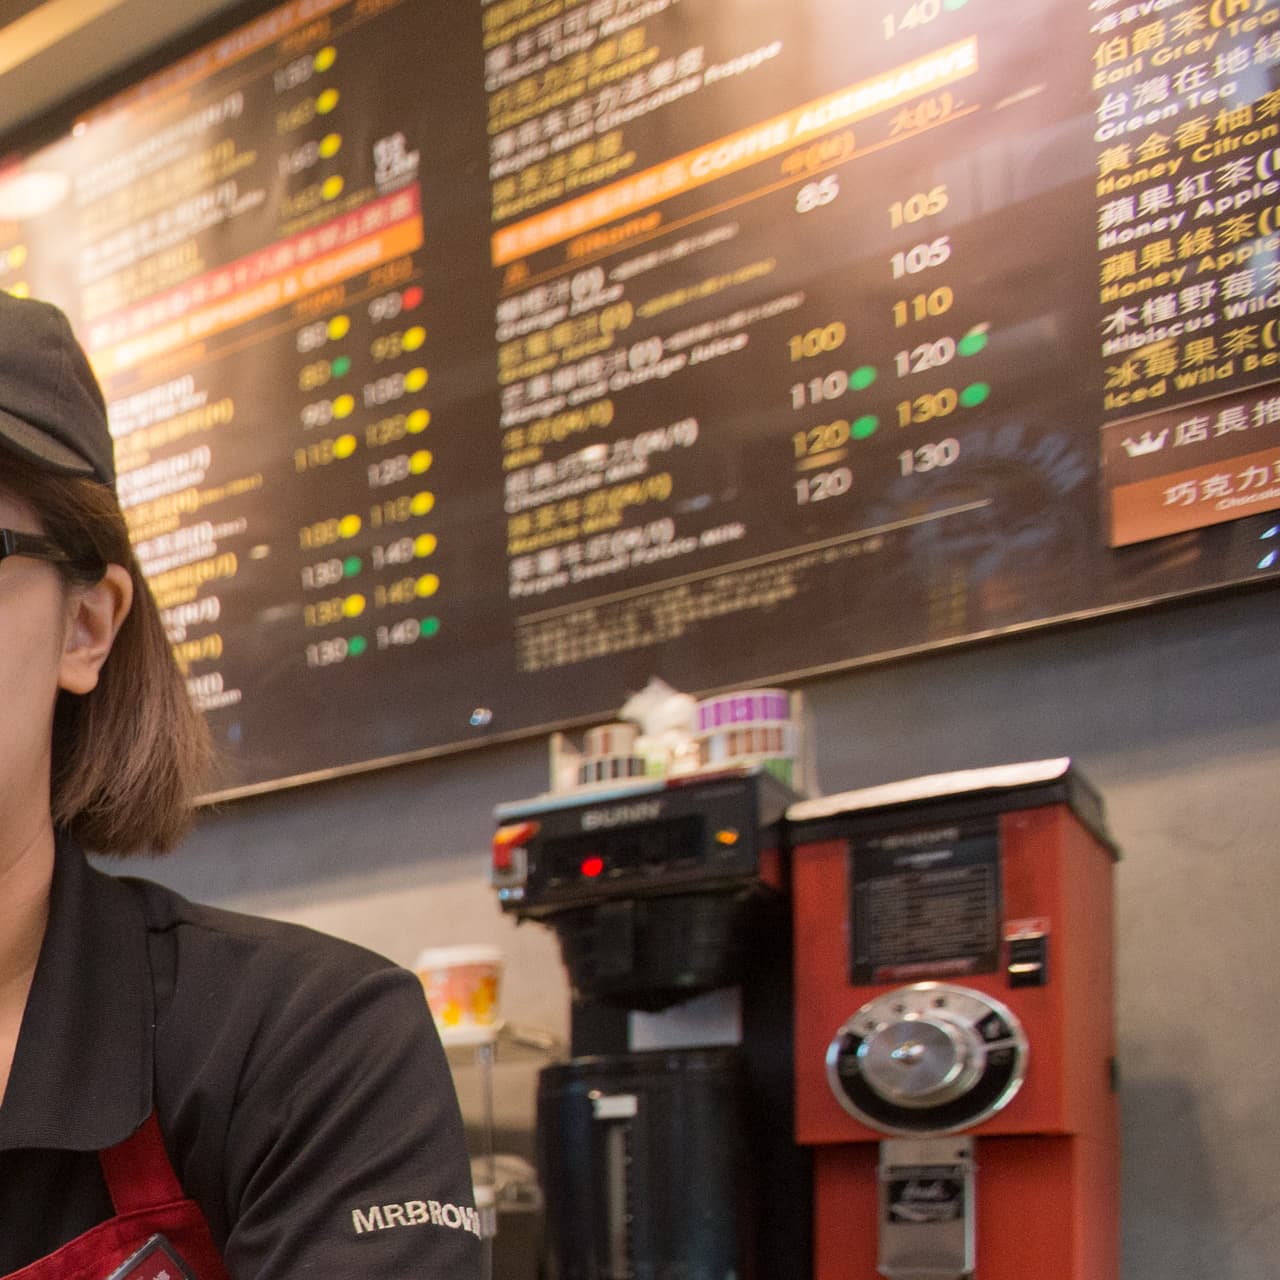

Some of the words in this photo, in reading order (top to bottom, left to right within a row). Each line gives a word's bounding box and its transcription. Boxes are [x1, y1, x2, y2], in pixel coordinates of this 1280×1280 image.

[1092, 57, 1143, 90] Earl
[1150, 31, 1219, 66] Grey
[1227, 8, 1280, 37] Tea
[1094, 102, 1180, 142] Green
[1186, 80, 1238, 110] Tea
[1096, 155, 1184, 197] Honey
[1191, 123, 1279, 163] Citron
[796, 174, 839, 214] 85
[889, 184, 948, 229] 105
[1097, 149, 1280, 232] 蘋果紅茶(
[1098, 211, 1187, 251] Honey
[1194, 181, 1280, 220] Apple
[890, 235, 951, 280] 105
[1099, 206, 1280, 286] 蘋果綠茶(
[1100, 266, 1188, 304] Honey
[1196, 237, 1280, 274] Apple
[892, 286, 954, 328] 110
[1102, 312, 1216, 357] Hibiscus
[787, 321, 847, 362] 100
[893, 336, 956, 378] 120
[790, 369, 849, 410] 110
[896, 387, 958, 428] 130
[1104, 379, 1167, 410] Iced
[1173, 360, 1234, 391] Wild
[1243, 350, 1280, 373] Be
[792, 419, 851, 458] 120
[897, 437, 961, 477] 130
[794, 466, 853, 505] 120
[1163, 460, 1280, 507] 巧克力
